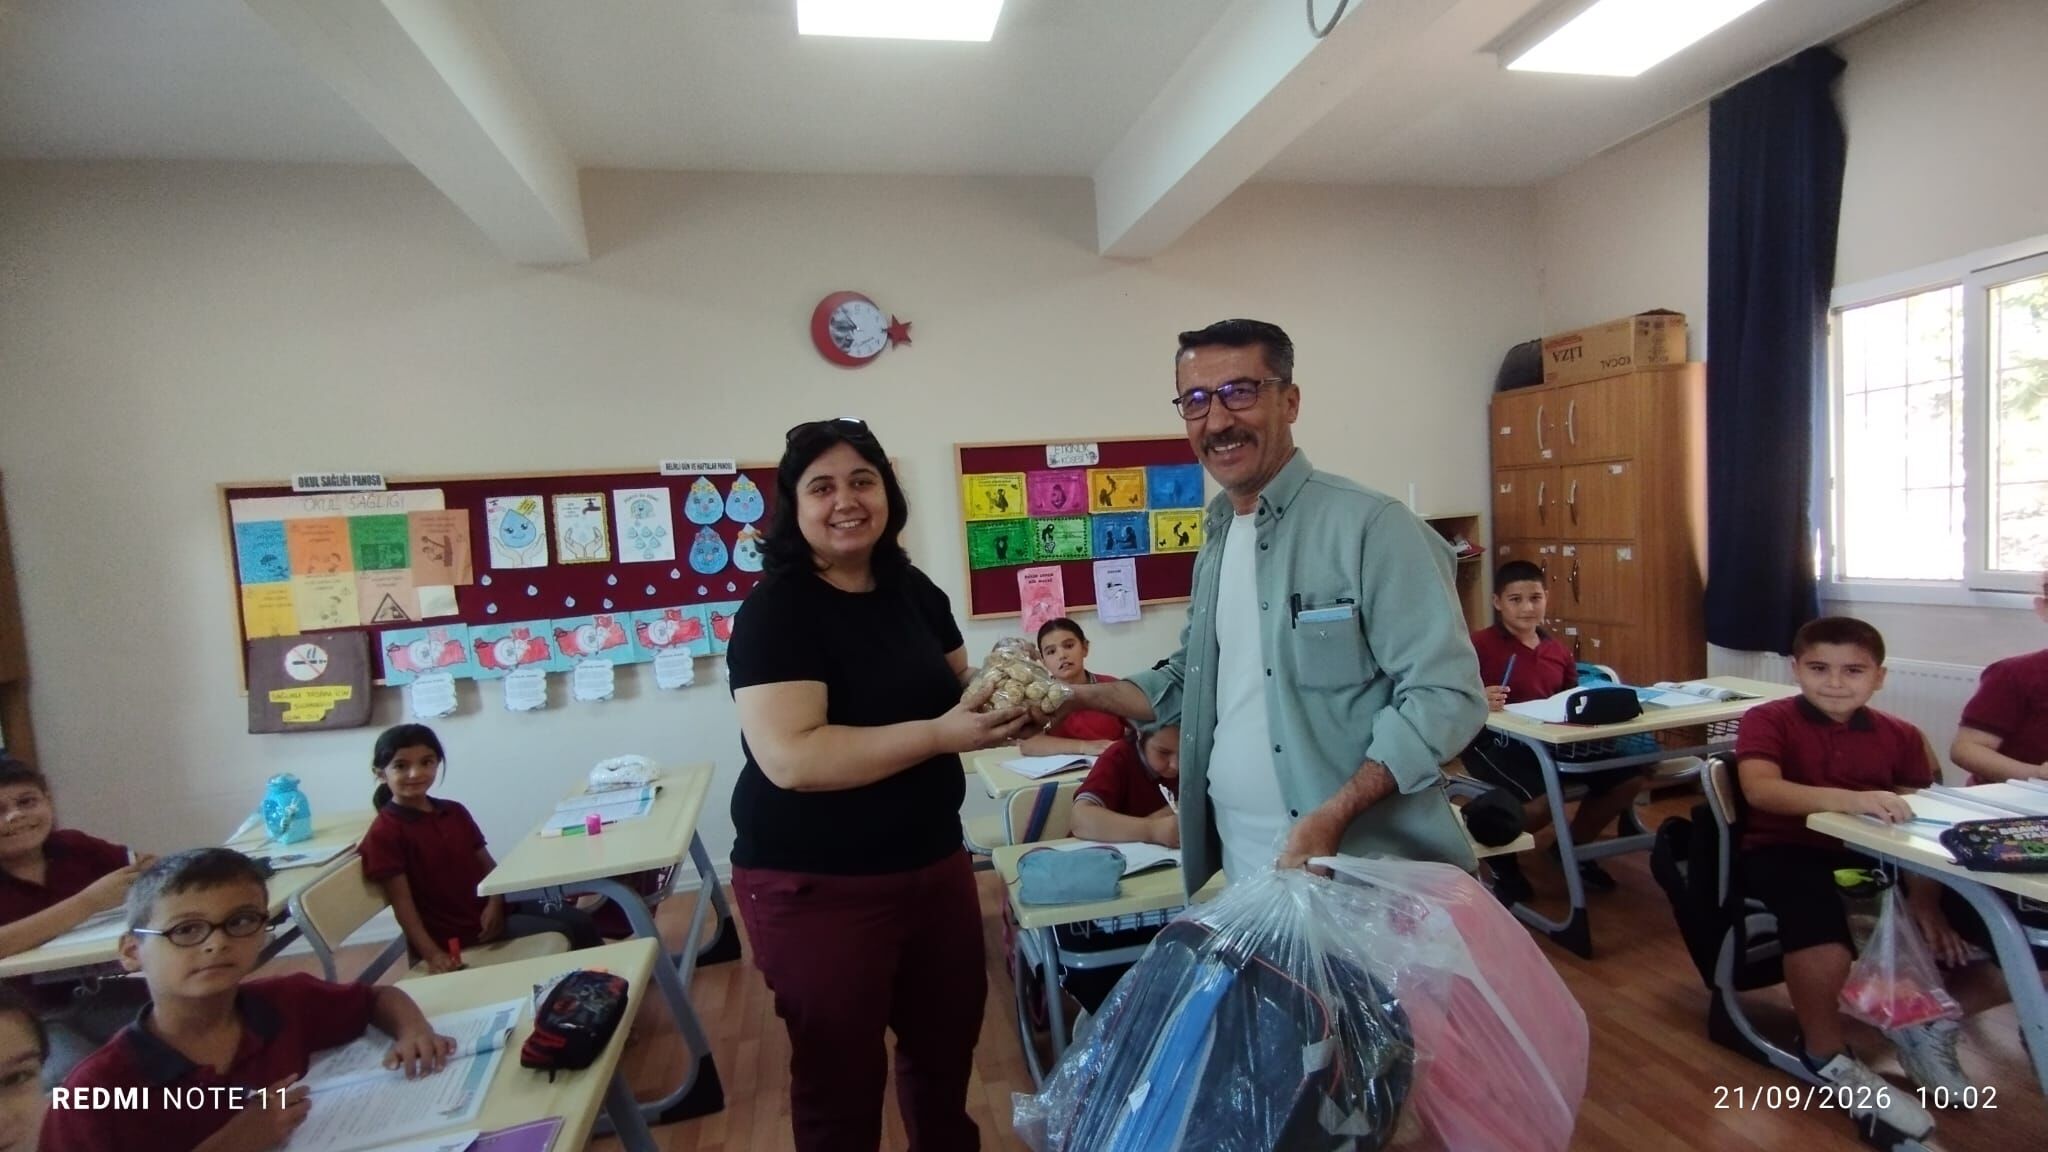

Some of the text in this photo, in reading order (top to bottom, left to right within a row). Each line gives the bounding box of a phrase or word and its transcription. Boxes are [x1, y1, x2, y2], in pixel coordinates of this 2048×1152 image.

[298, 473, 381, 488] OKUL SAĞLIĞI PANOSU
